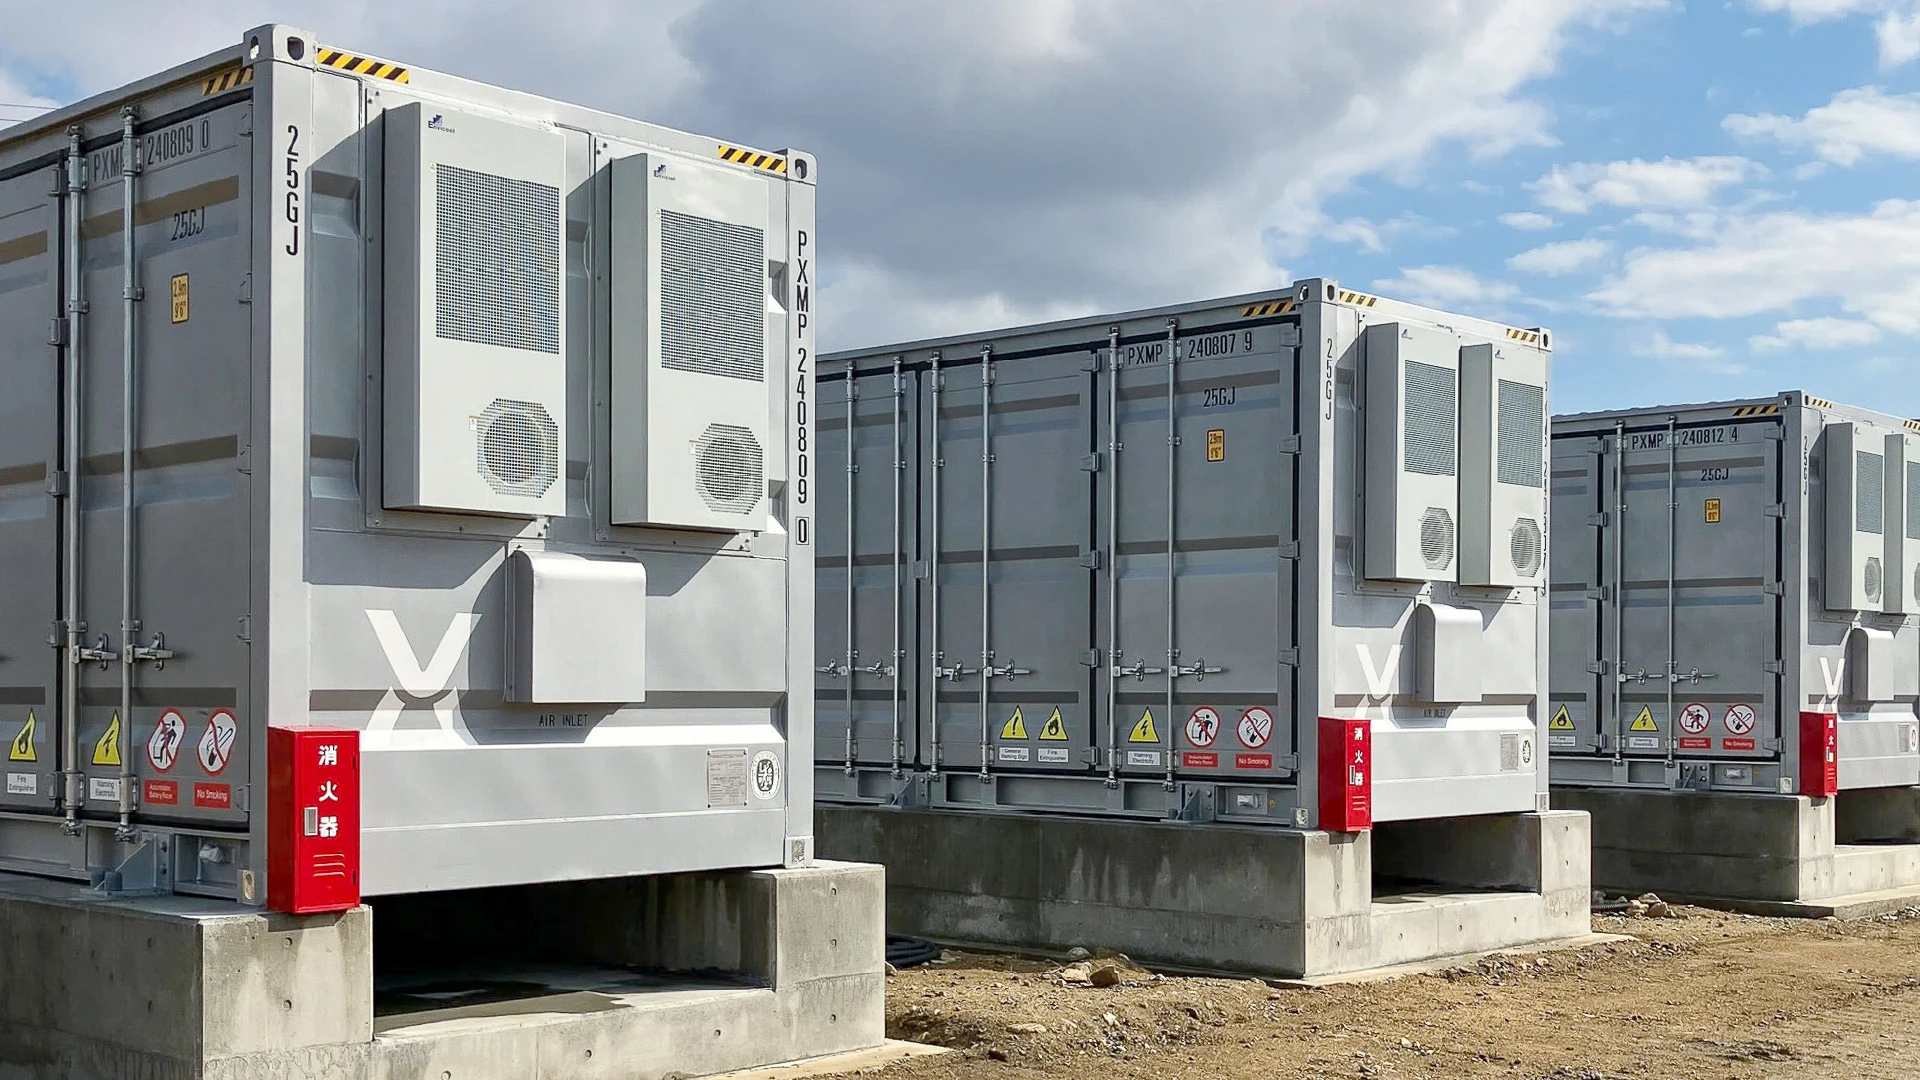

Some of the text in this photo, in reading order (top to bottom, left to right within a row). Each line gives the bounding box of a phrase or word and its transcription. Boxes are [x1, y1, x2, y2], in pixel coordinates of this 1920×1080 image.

[147, 124, 194, 165] 240809
[202, 119, 209, 149] 0
[286, 124, 299, 256] 25GJ
[170, 206, 205, 241] 25GJ
[1128, 331, 1253, 365] PXMP 240807 9
[796, 230, 809, 543] PXMP 240809 0
[1325, 338, 1333, 420] 25GJ
[1203, 386, 1236, 407] 25GJ
[1632, 426, 1737, 449] PXMP 240812 4
[1701, 468, 1729, 482] 25GJ
[539, 713, 589, 727] AIR INLET
[197, 789, 228, 802] No Smoking
[318, 744, 339, 838] 消火器
